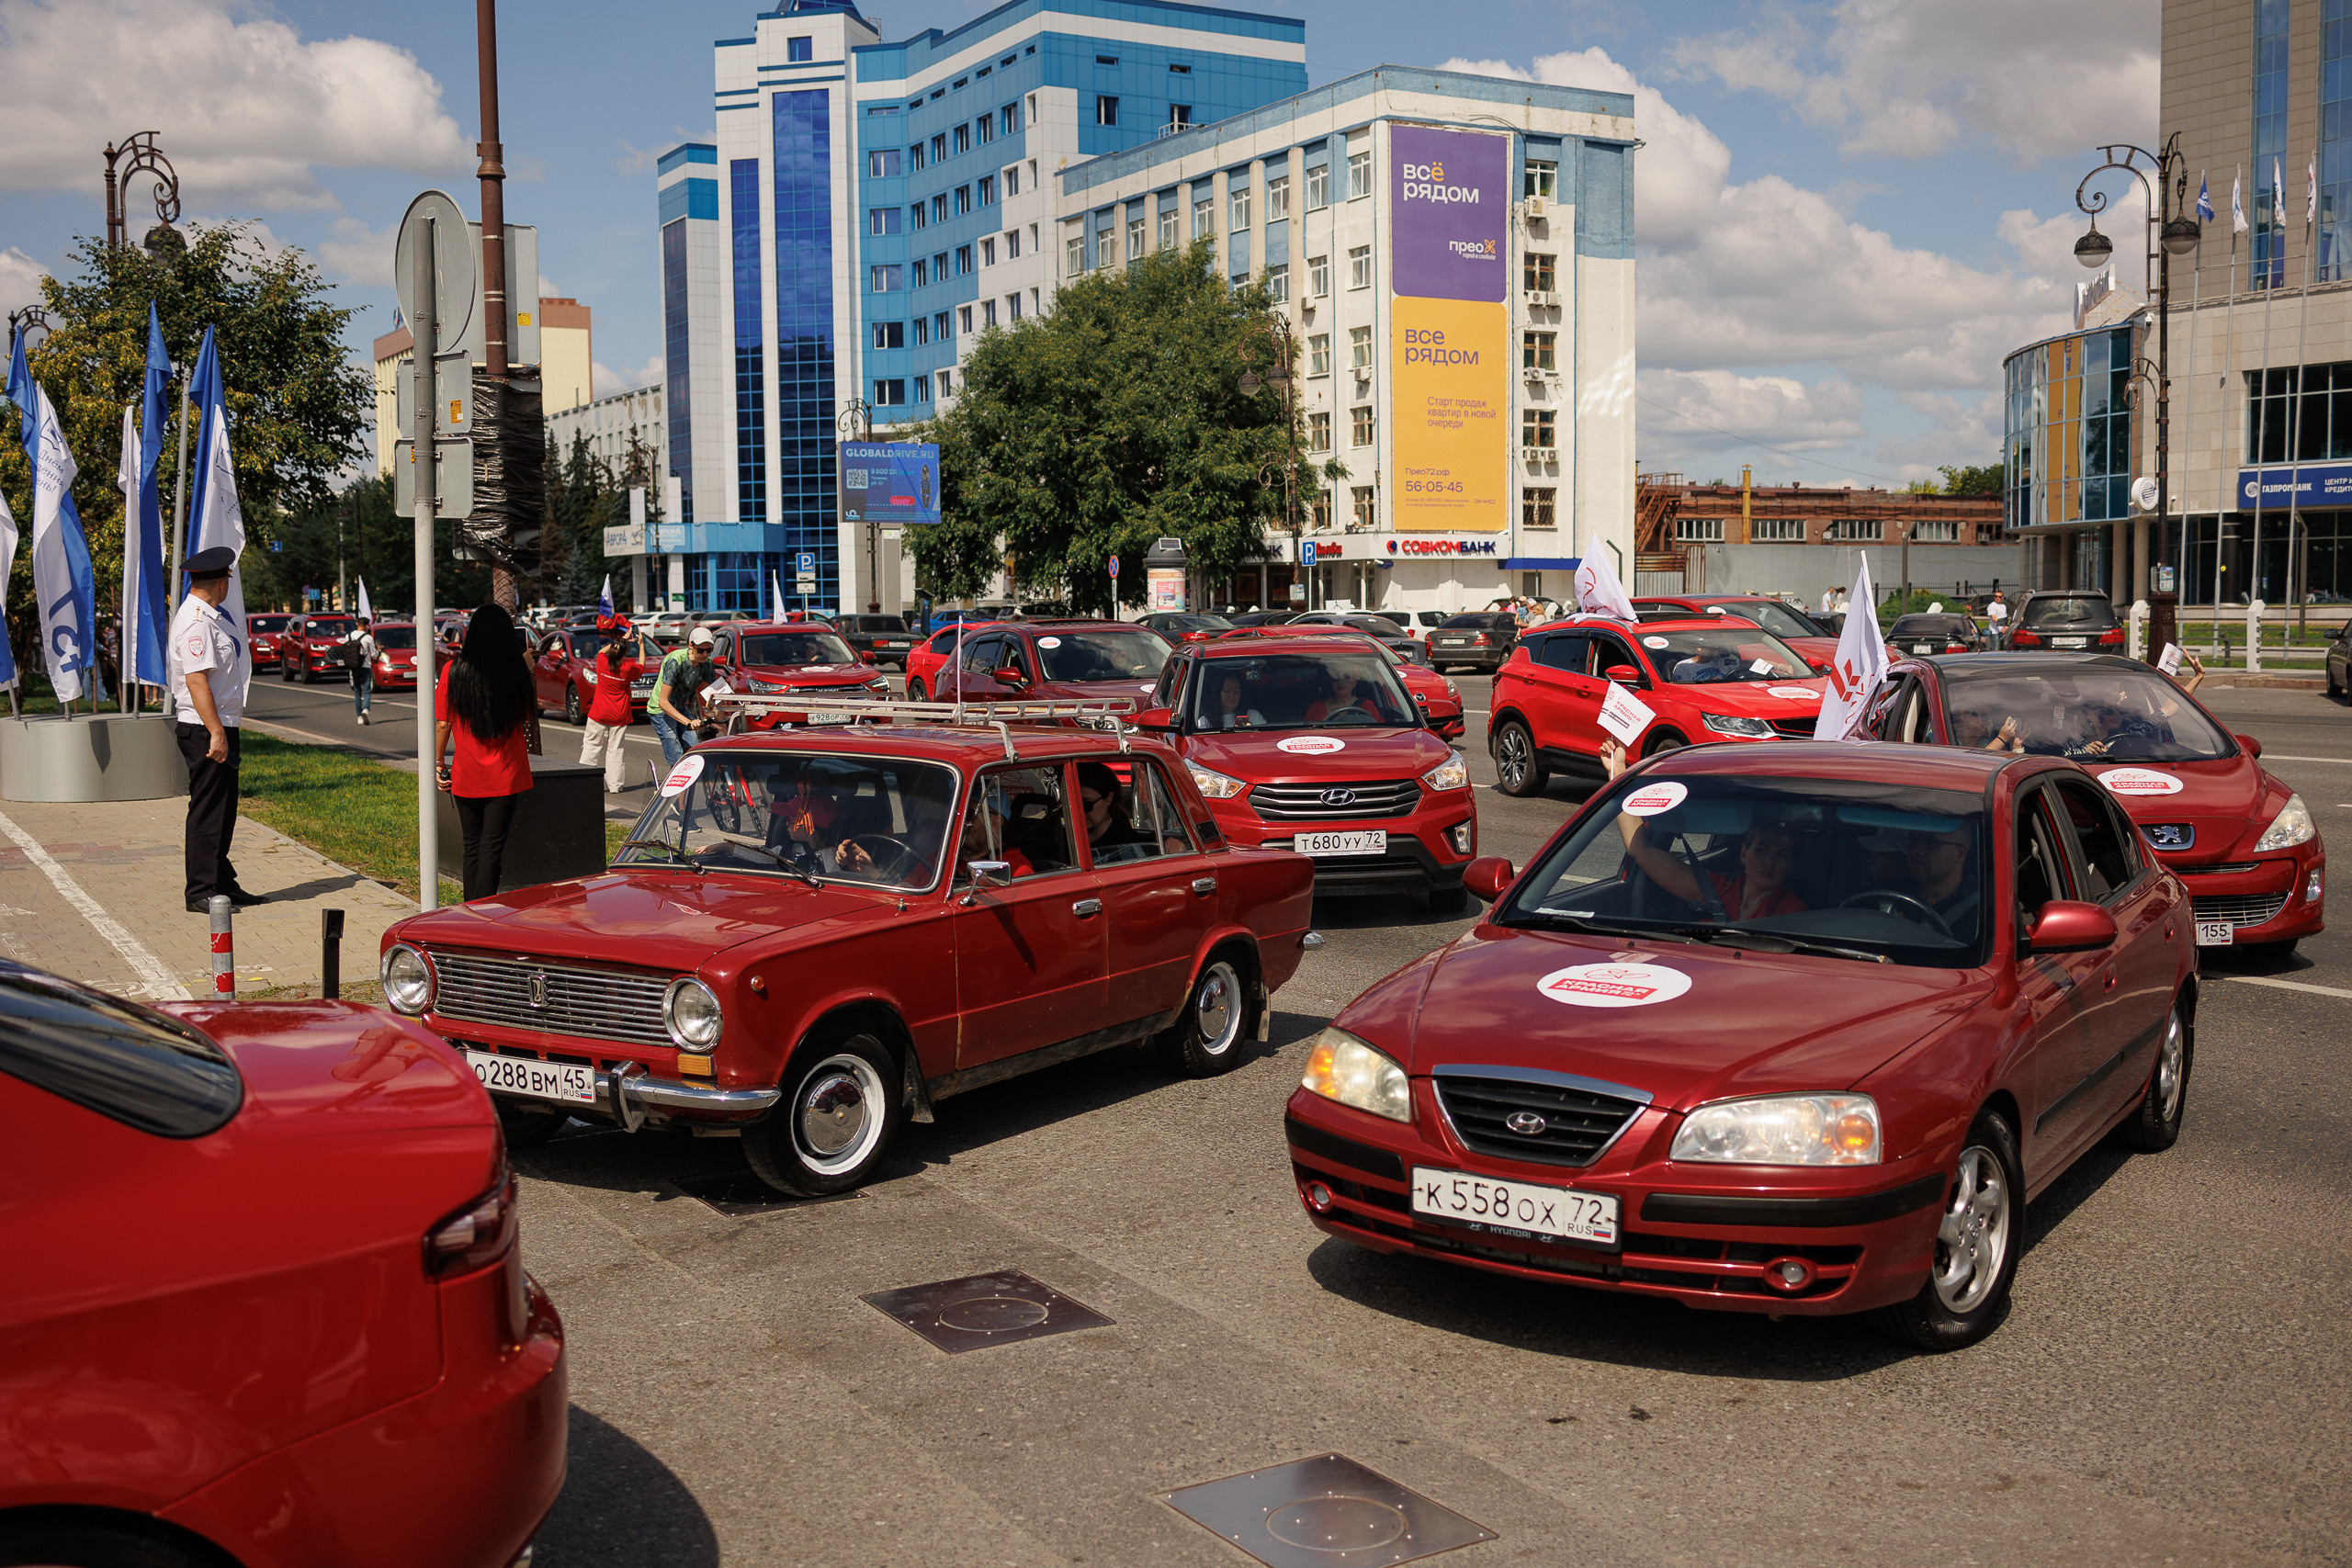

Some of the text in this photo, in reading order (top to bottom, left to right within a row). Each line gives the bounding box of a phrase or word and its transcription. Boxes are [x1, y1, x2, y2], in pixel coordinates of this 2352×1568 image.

[1403, 162, 1444, 182] всё
[1403, 182, 1479, 204] рядом
[1405, 329, 1445, 344] все
[1405, 347, 1479, 367] рядом
[1427, 396, 1487, 409] Старт продаж
[1427, 408, 1462, 419] квартир
[1471, 409, 1497, 419] новой
[1427, 419, 1464, 429] очереди
[845, 448, 934, 458] GLOBALDRIVE.RU
[1405, 468, 1450, 476] Прео72.рф
[2324, 478, 2348, 486] ЦЕНТР
[2324, 485, 2352, 493] КРЕДИТ
[1401, 540, 1497, 554] СОВКОМБАНК
[2201, 924, 2228, 937] 155
[1555, 984, 1622, 996] АРМИЯ
[1562, 979, 1650, 994] КРАСНАЯ
[563, 1068, 586, 1089] 45
[563, 1089, 581, 1098] RUS
[1571, 1196, 1603, 1225] 72
[1489, 1224, 1532, 1239] HYUNDAI
[1566, 1222, 1593, 1235] RUS
